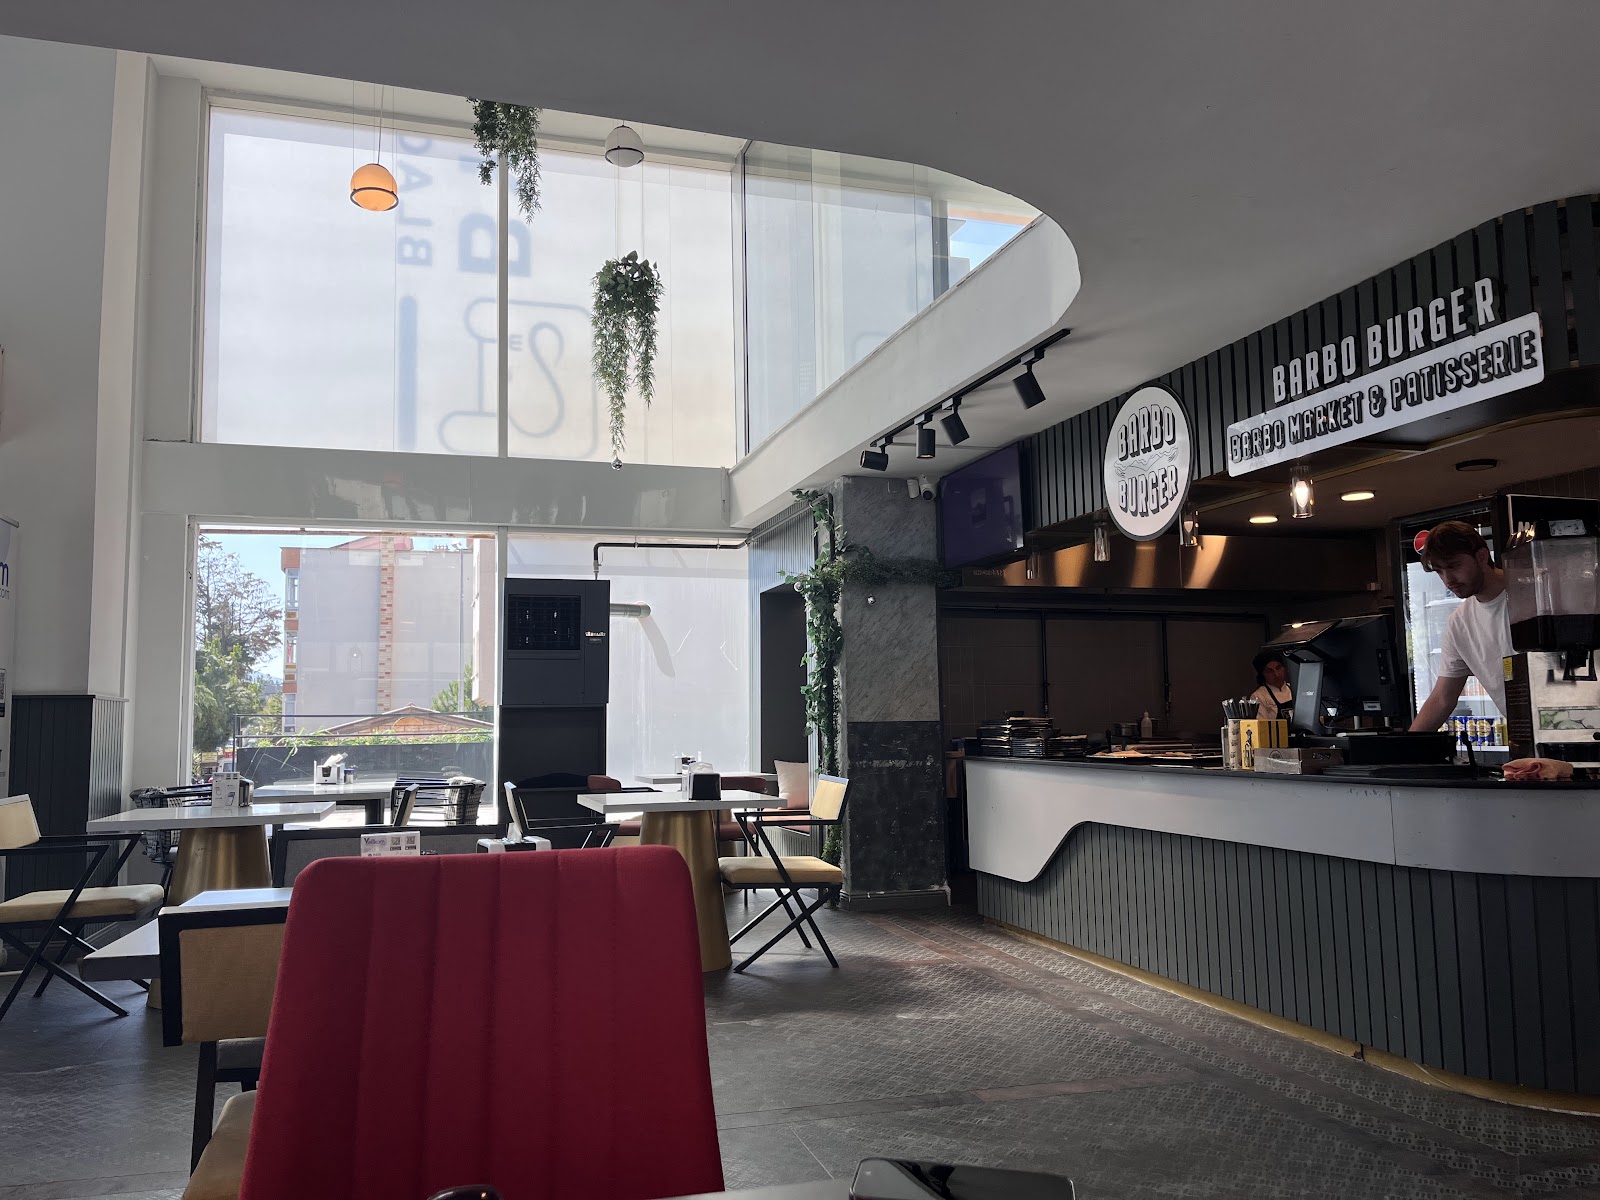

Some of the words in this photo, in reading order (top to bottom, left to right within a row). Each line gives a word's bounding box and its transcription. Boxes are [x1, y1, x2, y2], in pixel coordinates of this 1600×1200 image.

[1272, 335, 1357, 404] BARBO
[1367, 277, 1496, 368] BURGER
[1117, 403, 1177, 462] BARBO
[1230, 420, 1286, 463] BARBO
[1288, 391, 1364, 445] MARKET
[1368, 385, 1387, 417] &
[1390, 330, 1538, 412] PATISSERIE
[1118, 464, 1179, 518] BURGER
